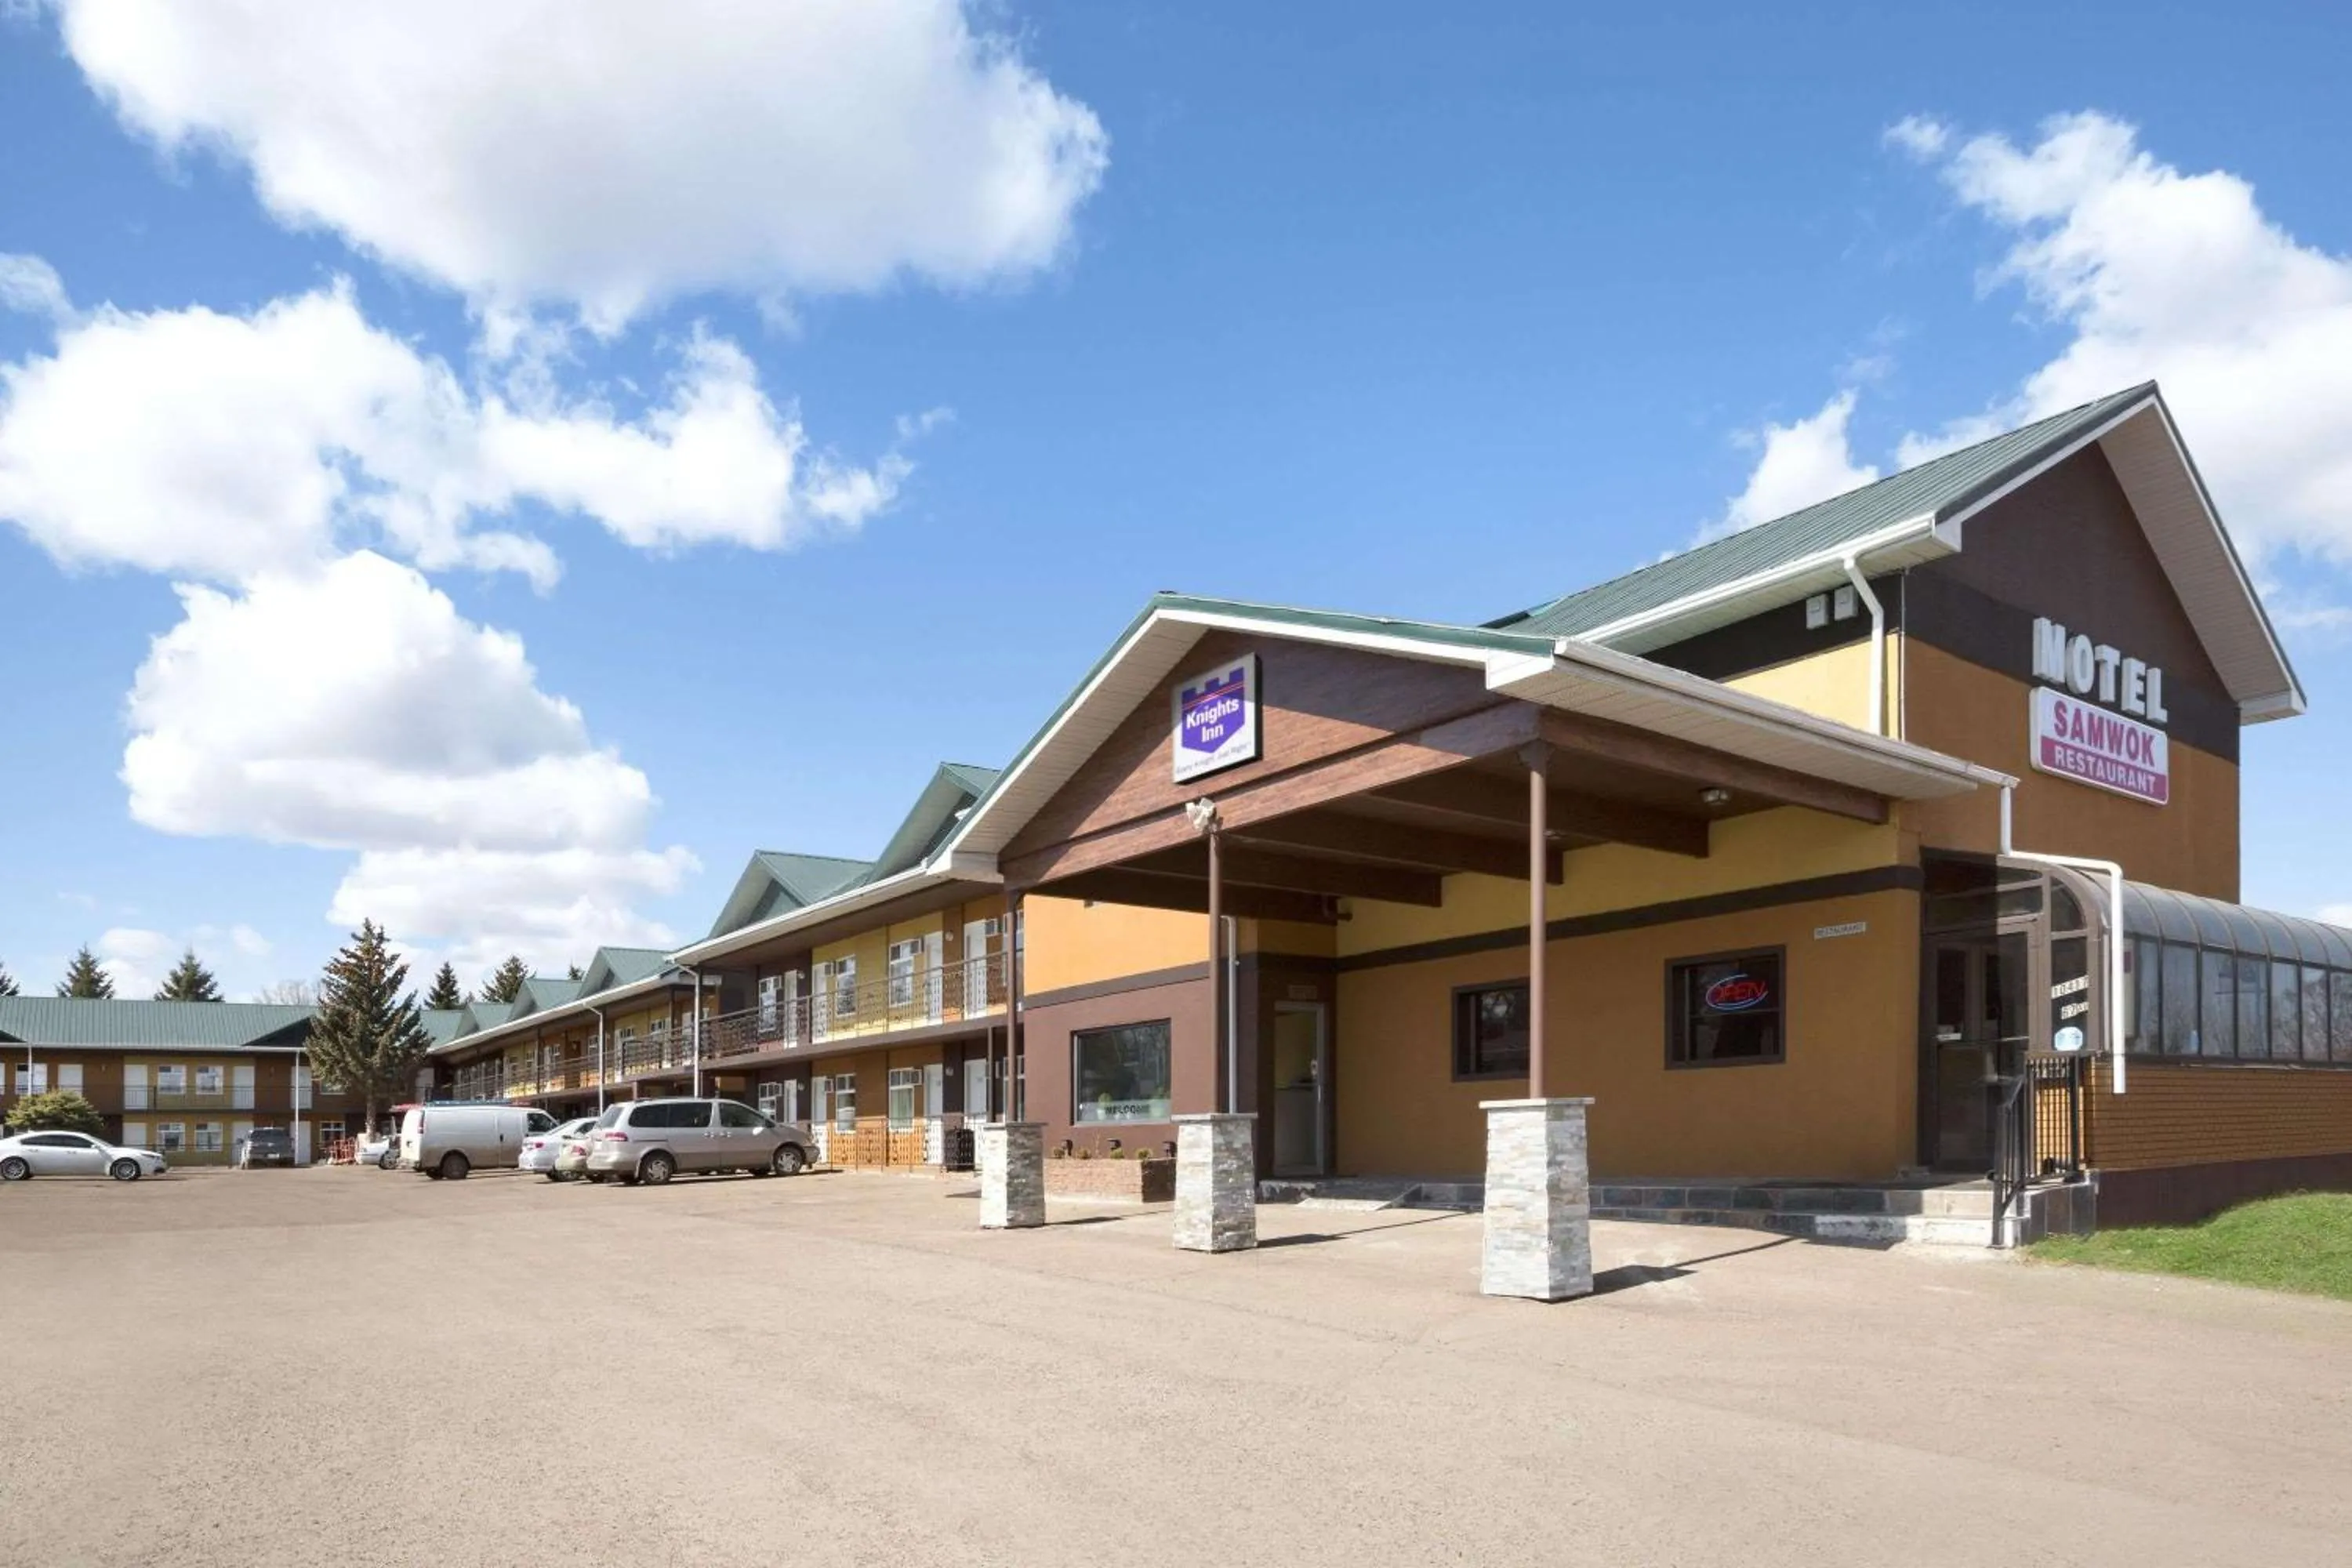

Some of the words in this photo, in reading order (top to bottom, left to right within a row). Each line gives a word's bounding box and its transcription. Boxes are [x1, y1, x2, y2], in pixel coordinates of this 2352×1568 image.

[2032, 617, 2168, 723] MOTEL
[1185, 698, 1240, 730] Knights
[1201, 723, 1224, 743] Inn
[2053, 699, 2155, 768] SAMWOK
[2053, 745, 2156, 795] RESTAURANT
